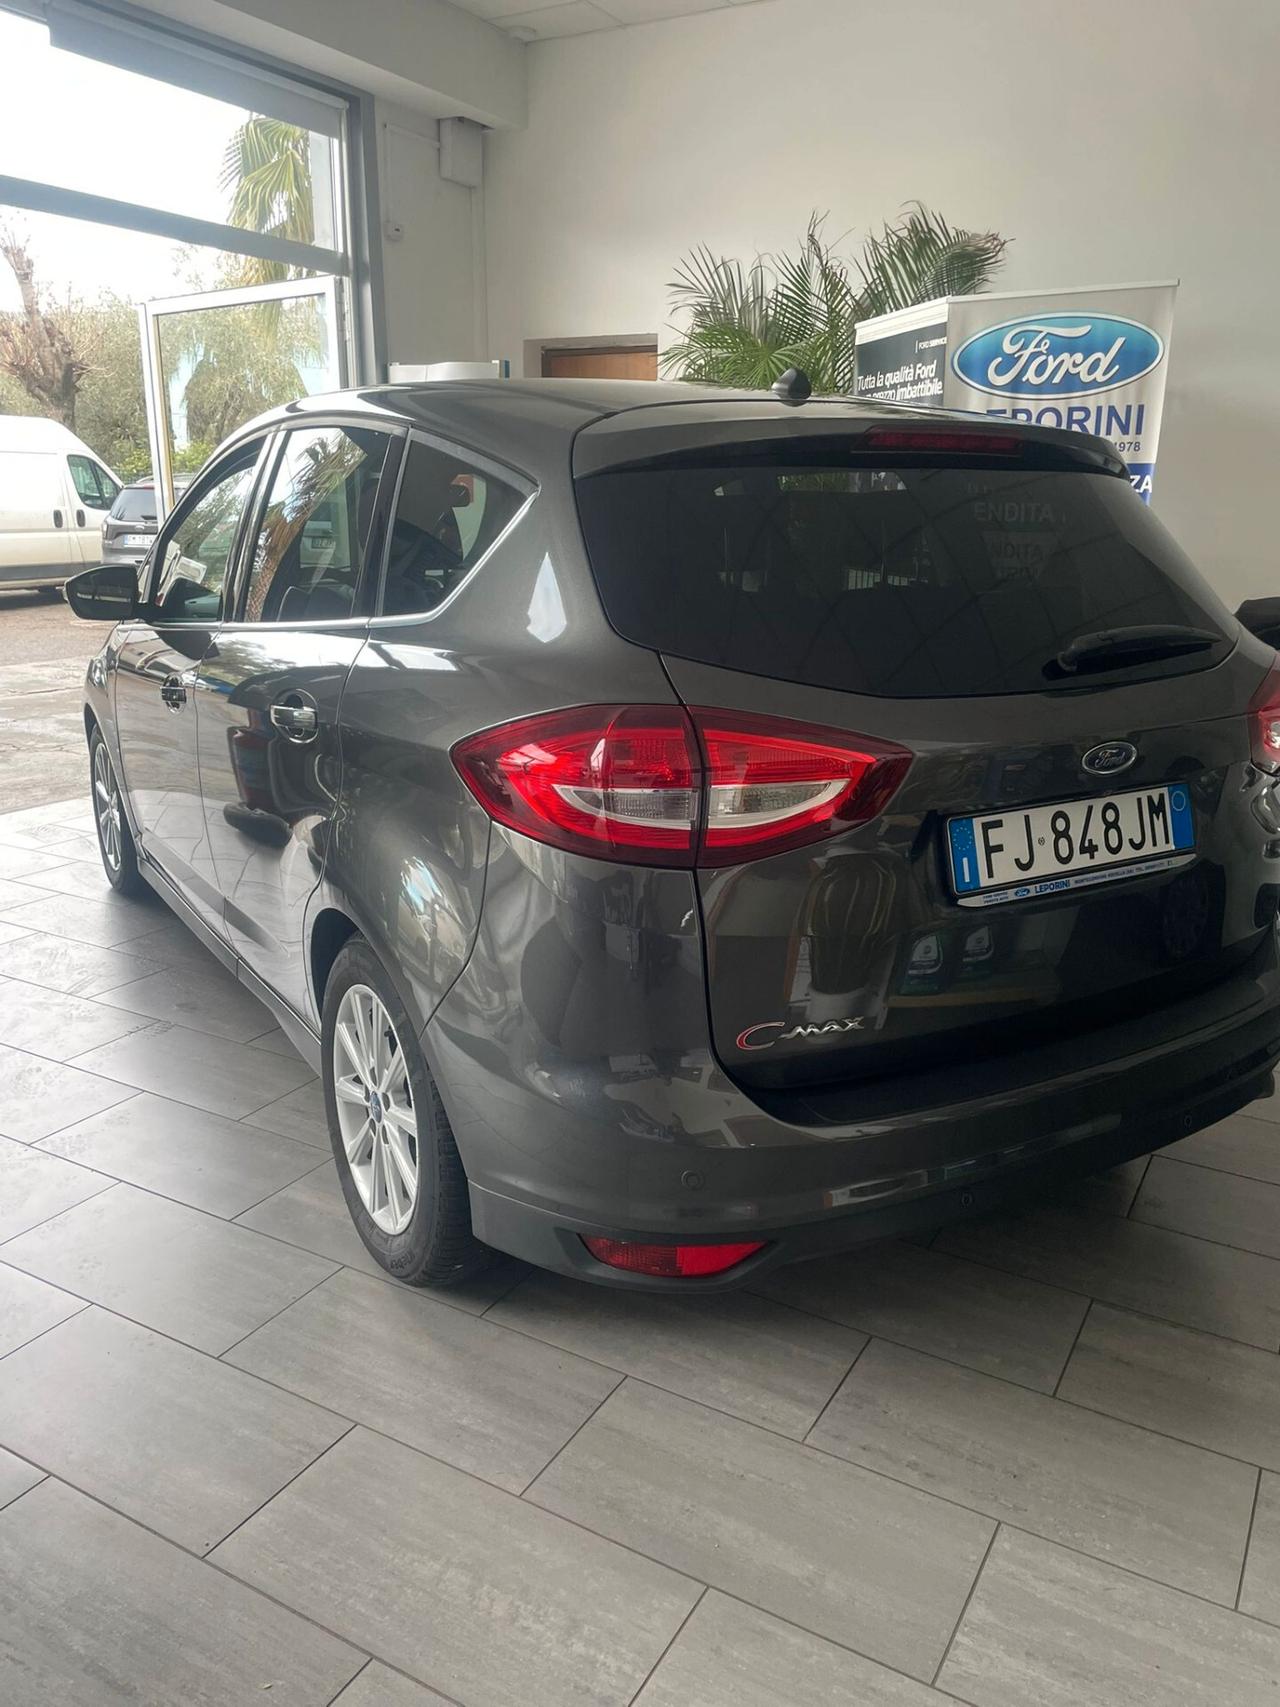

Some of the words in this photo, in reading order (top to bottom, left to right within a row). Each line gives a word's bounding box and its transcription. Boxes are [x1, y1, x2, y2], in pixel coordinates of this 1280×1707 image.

[858, 374, 876, 391] Tutta
[876, 371, 884, 387] la
[884, 364, 914, 388] qualità
[914, 359, 936, 380] Ford
[988, 325, 1126, 386] Ford
[981, 815, 1036, 879] FJ
[1050, 792, 1170, 865] 848JM
[1035, 880, 1071, 894] LEPORINI
